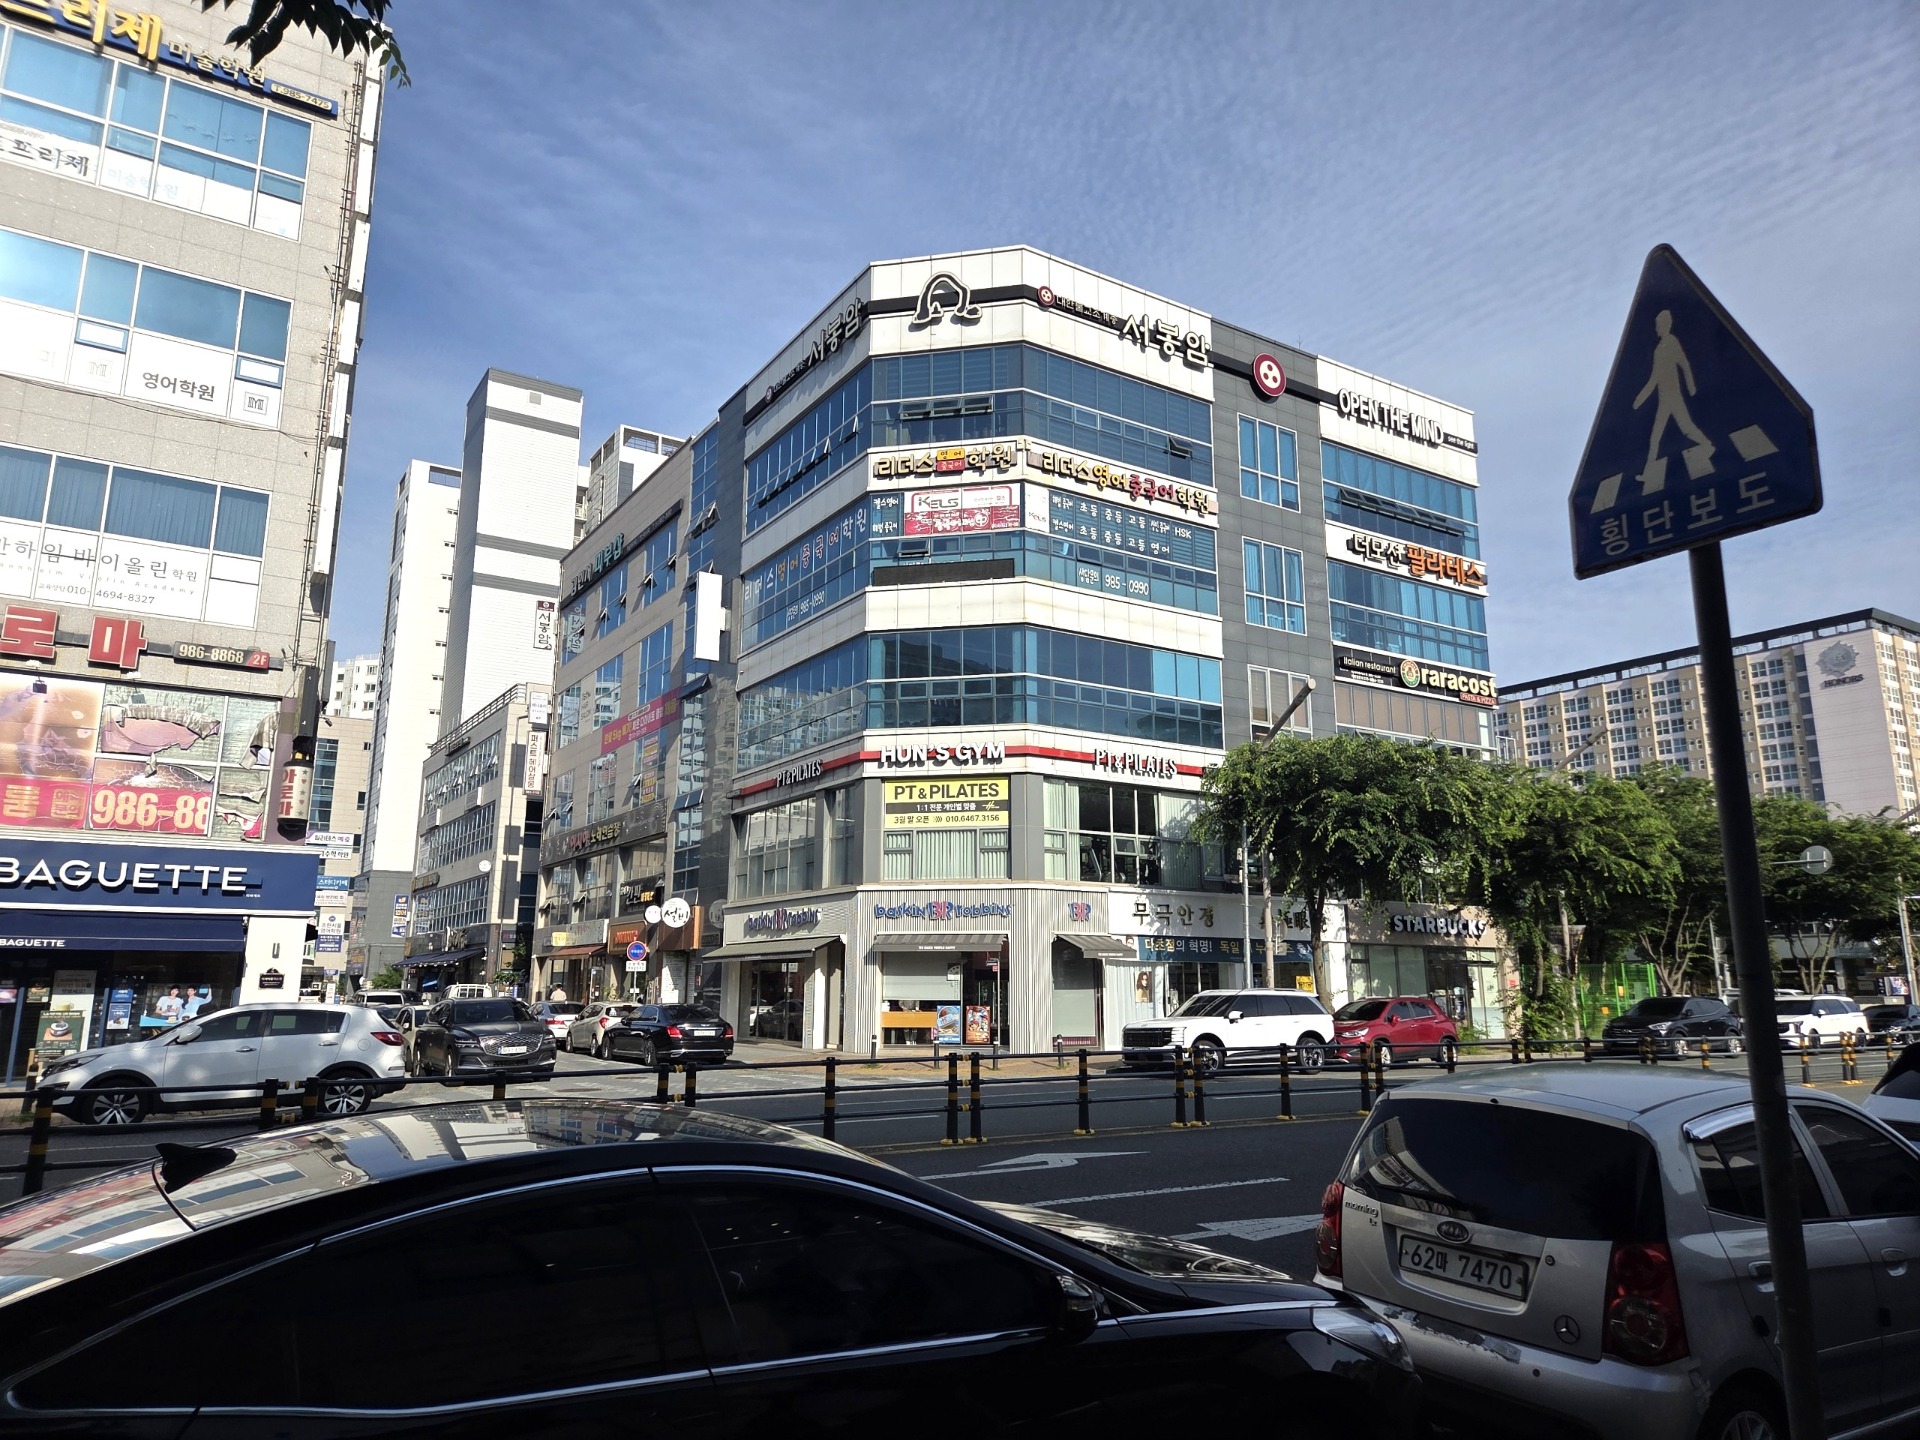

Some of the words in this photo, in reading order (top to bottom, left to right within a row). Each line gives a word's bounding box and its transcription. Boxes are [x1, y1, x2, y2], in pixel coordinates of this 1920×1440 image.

[169, 40, 267, 88] 미술학원
[808, 297, 863, 367] 서봉암
[1122, 313, 1212, 368] 서봉암
[142, 371, 215, 403] 영어학원
[1339, 388, 1379, 424] OPEN
[1380, 402, 1411, 435] THE
[1410, 412, 1444, 445] MIND
[878, 452, 934, 476] 리더스
[965, 444, 1012, 472] 학원
[1105, 508, 1122, 524] 중등
[1128, 515, 1147, 530] 고등
[1175, 526, 1192, 540] HSK
[1600, 472, 1775, 556] 횡단보도
[1105, 530, 1122, 546] 중등
[1128, 537, 1147, 553] 고등
[1151, 542, 1171, 556] 영어
[74, 547, 168, 579] 바이올린
[172, 568, 198, 583] 학원
[178, 643, 244, 665] 986-8868
[252, 653, 268, 667] 2F
[1343, 656, 1364, 668] Italian
[1364, 662, 1396, 674] restaurant
[1420, 667, 1498, 698] raracost
[954, 741, 1006, 761] GYM
[945, 814, 1000, 824] 010.6467.3156
[0, 858, 248, 892] BAGUETTE
[873, 903, 926, 920] baskin
[926, 901, 954, 920] BR
[955, 902, 1011, 919] robbins
[1068, 902, 1092, 923] BR
[1132, 901, 1214, 928] 무극안경
[1393, 915, 1487, 939] STARBUCKS
[0, 938, 66, 948] BAGUETTE
[1144, 937, 1185, 953] 다초점의
[1188, 939, 1213, 953] 혁명!
[1219, 940, 1240, 954] 독일
[1345, 1201, 1379, 1218] morning
[1410, 1244, 1448, 1273] 62마
[1458, 1254, 1512, 1290] 7470
